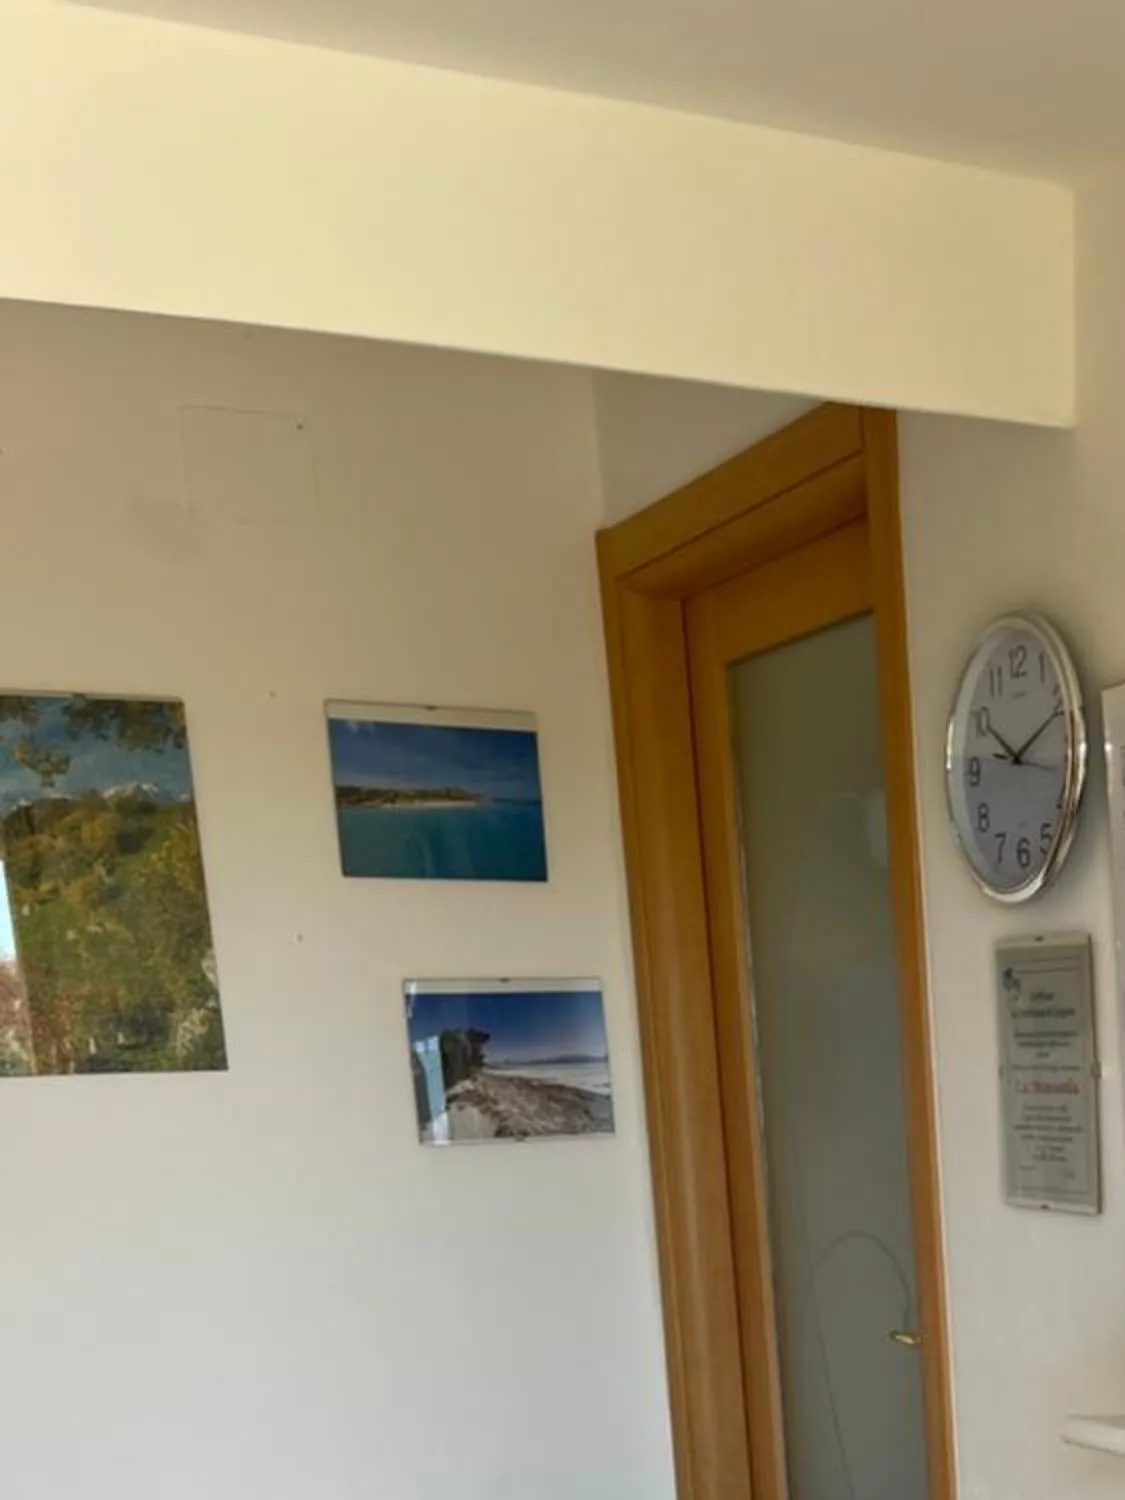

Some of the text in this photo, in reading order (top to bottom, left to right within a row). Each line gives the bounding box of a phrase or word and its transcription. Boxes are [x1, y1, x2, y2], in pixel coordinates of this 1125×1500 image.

[1008, 645, 1027, 679] 12
[1038, 653, 1046, 684] 1
[989, 666, 1003, 698] 11
[971, 706, 990, 737] 10
[968, 757, 981, 787] 9
[977, 803, 990, 833] 8
[994, 833, 1007, 864] 7
[1016, 838, 1030, 868] 6
[1040, 823, 1053, 858] 5
